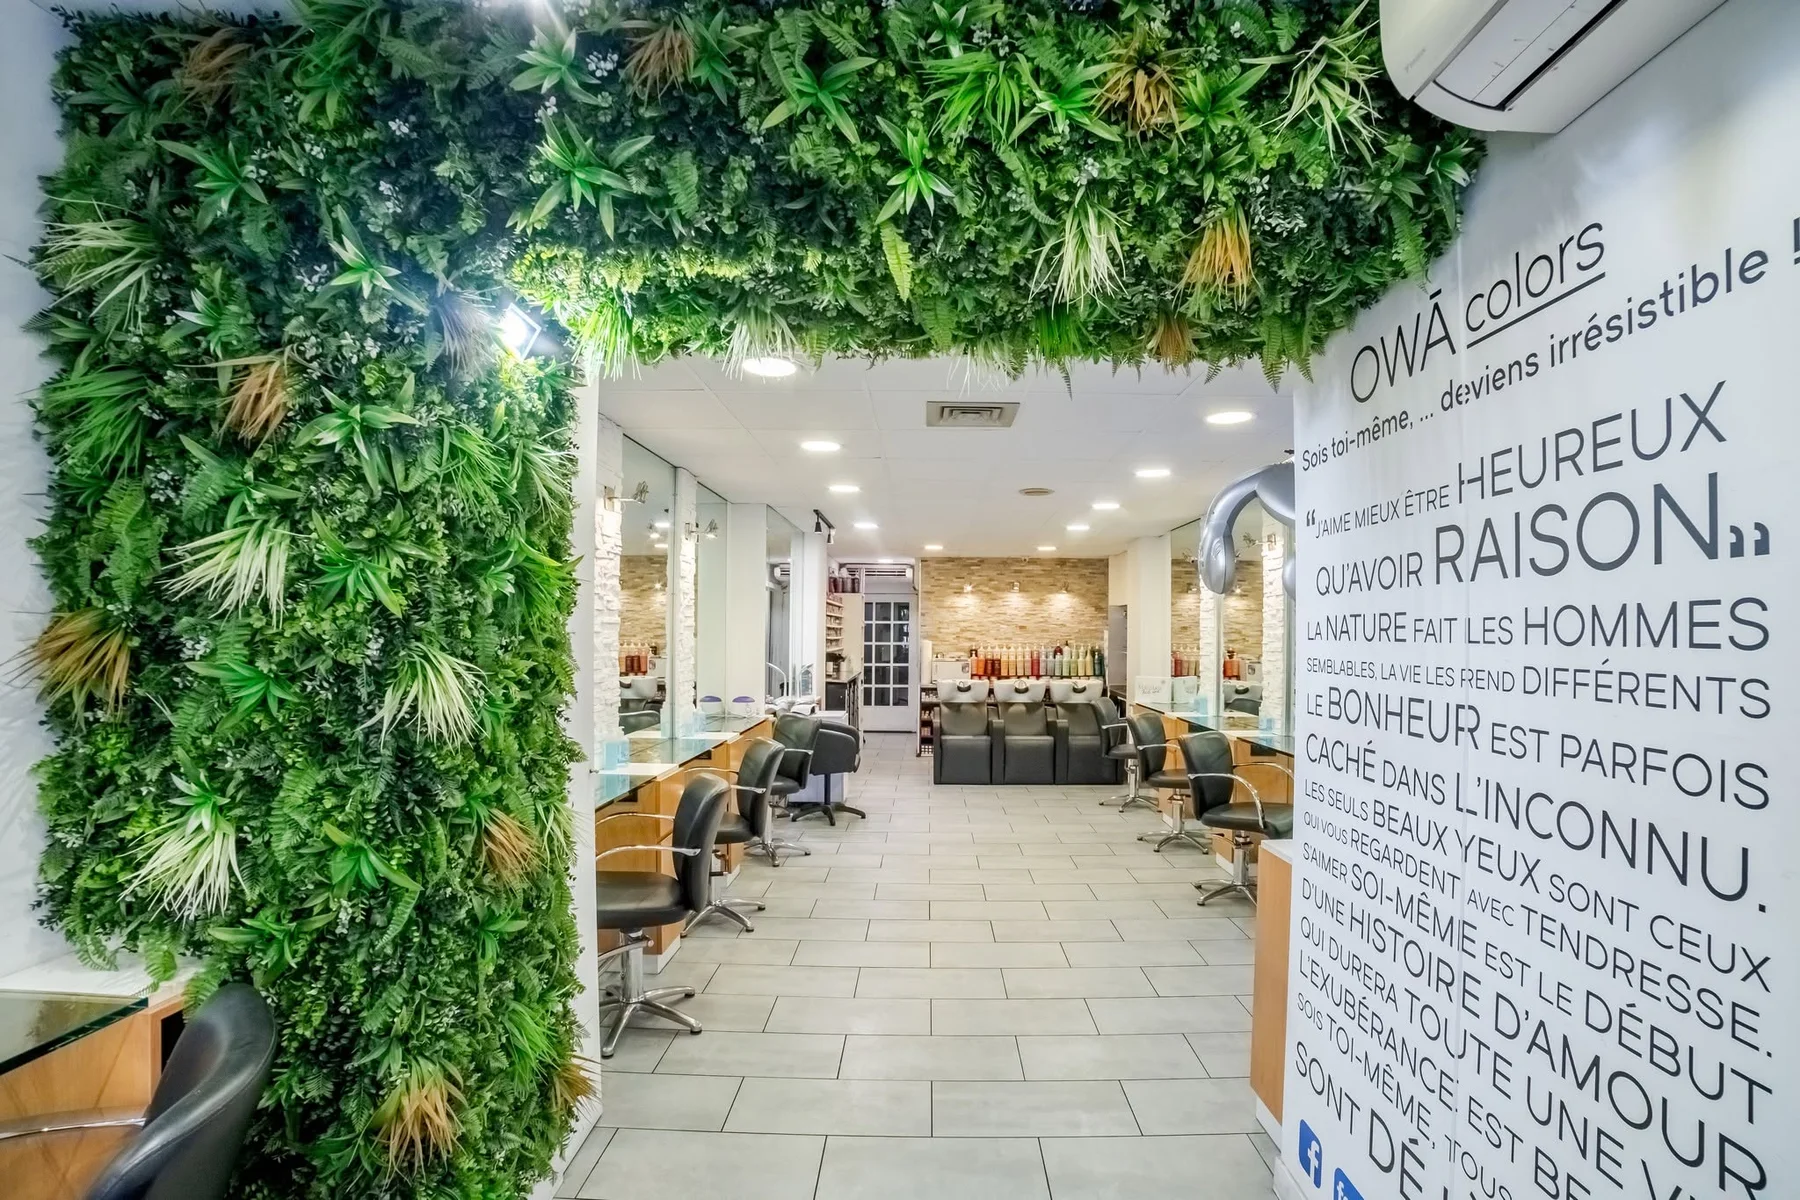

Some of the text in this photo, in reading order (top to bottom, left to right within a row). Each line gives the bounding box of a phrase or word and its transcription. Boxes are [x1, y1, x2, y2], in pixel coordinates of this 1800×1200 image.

[1466, 223, 1604, 332] colors
[1302, 444, 1328, 472] Sois
[1331, 409, 1414, 458] toi-même,
[1441, 353, 1539, 411] deviens
[1550, 247, 1769, 367] irrésistible
[1355, 498, 1399, 528] MIEUX
[1405, 485, 1449, 517] ÊTRE
[1458, 380, 1727, 504] HEUREUX
[1308, 597, 1769, 651] LA NATURE FAIT LES HOMMES
[1317, 552, 1422, 596] QU'AVOIR
[1307, 658, 1771, 719] SEMBLABLES, LA VIE LES REND DIFFÉRENTS
[1307, 686, 1769, 810] LE BONHEUR EST PARFOIS
[1305, 779, 1771, 993] LES SEULS BEAUX YEUX SONT CEUX
[1306, 733, 1766, 913] CACHÉ DANS L'INCONNU.
[1303, 842, 1773, 1124] S'AIMER SOI-MÊME EST LE DÉBUT
[1304, 812, 1772, 1058] QUI VOUS REGARDENT AVEC TENDRESSE.
[1296, 1041, 1360, 1135] SONT
[1298, 993, 1323, 1030] SOIS
[1327, 1013, 1435, 1149] TOI-MÊME,
[1301, 916, 1324, 951] QUI
[1329, 936, 1398, 1012] DURERA
[1404, 988, 1512, 1100] TOUTE
[1527, 1076, 1624, 1190] UNE
[1303, 878, 1767, 1200] D'UNE HISTOIRE D'AMOUR
[1468, 1095, 1523, 1163] EST
